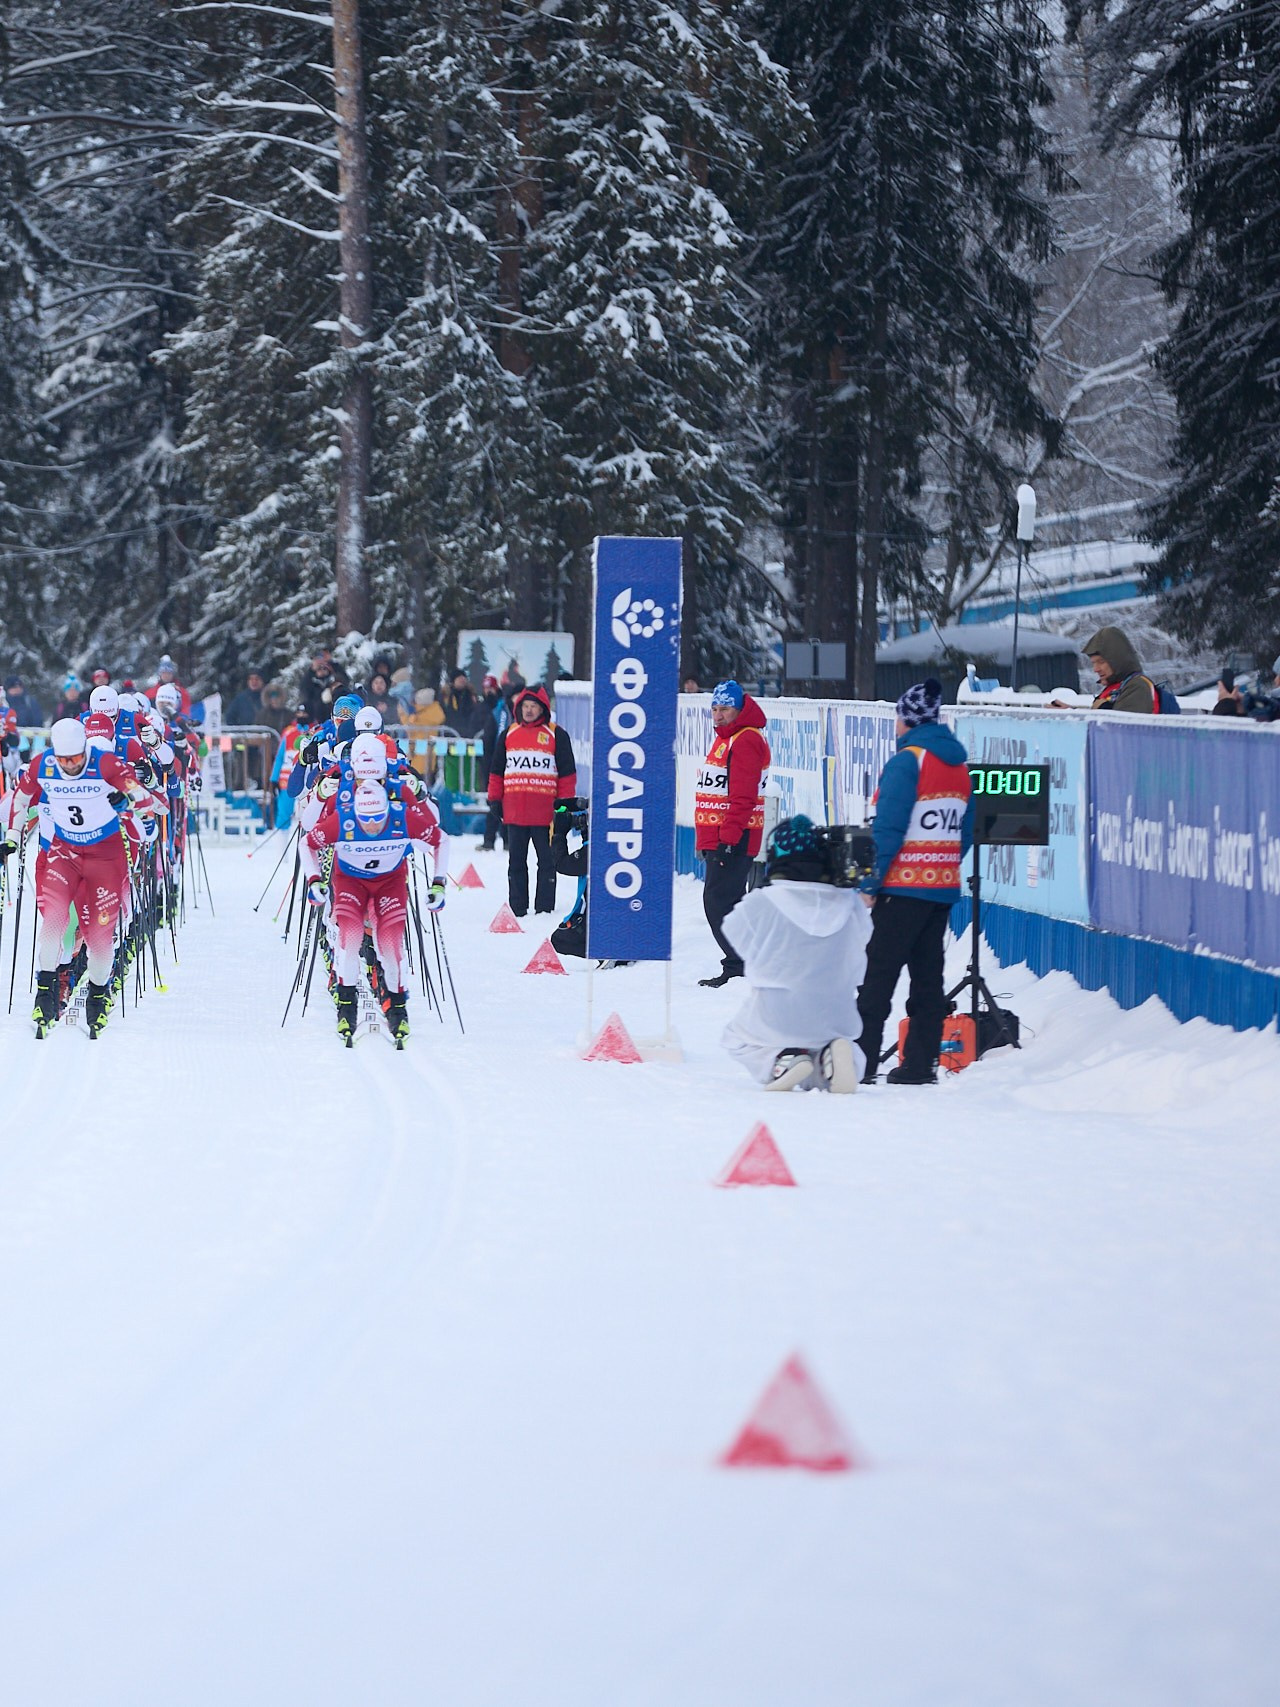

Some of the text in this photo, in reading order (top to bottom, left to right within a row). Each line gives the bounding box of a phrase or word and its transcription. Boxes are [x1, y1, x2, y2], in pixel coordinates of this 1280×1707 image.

[605, 657, 648, 899] ФОСАГРО
[54, 786, 101, 794] ФОСАГРО
[68, 805, 84, 826] 3
[920, 808, 962, 834] СУД
[355, 843, 405, 853] ФОСАГРО
[364, 860, 380, 869] 4
